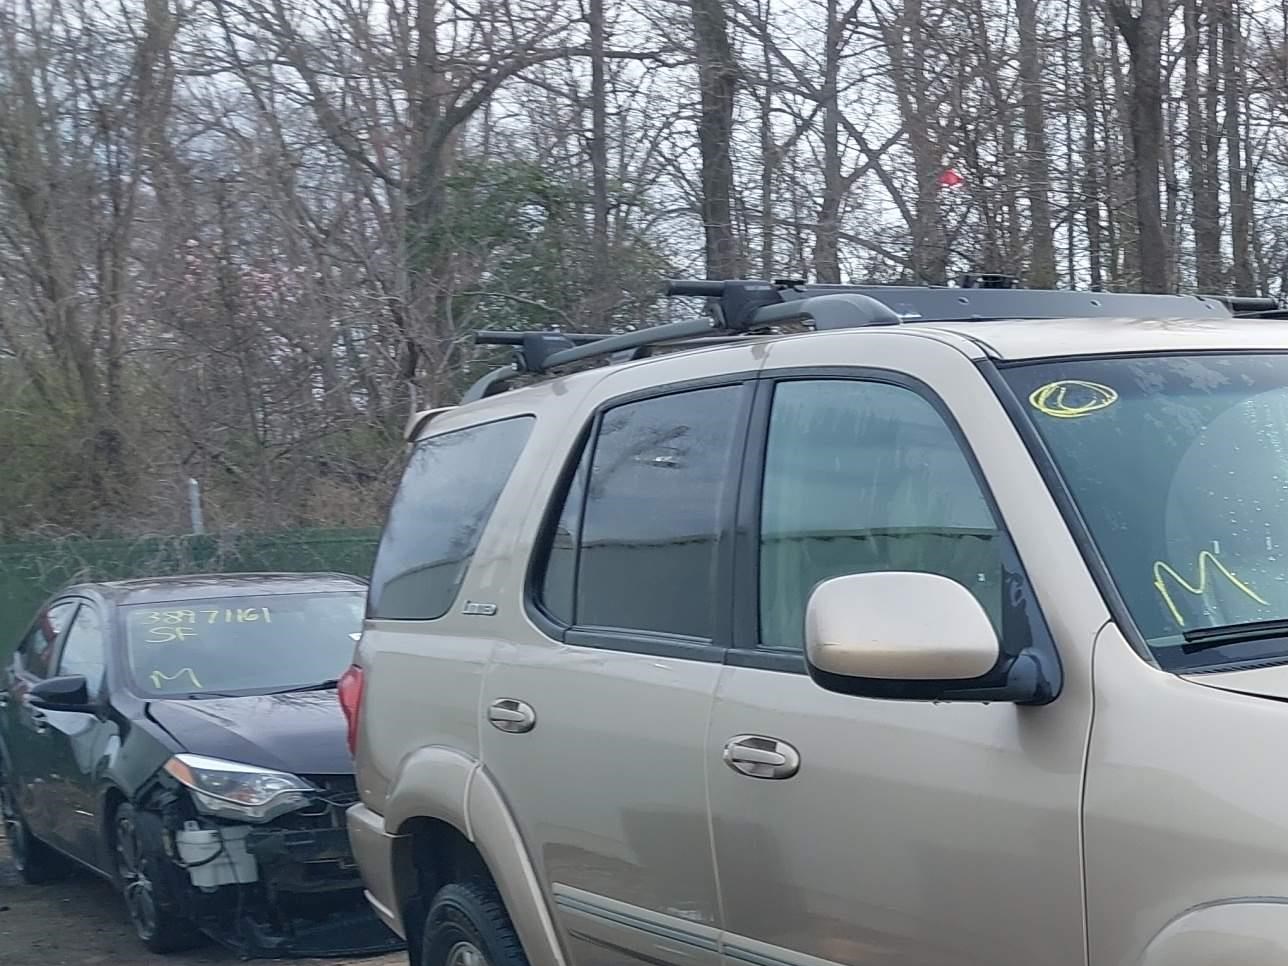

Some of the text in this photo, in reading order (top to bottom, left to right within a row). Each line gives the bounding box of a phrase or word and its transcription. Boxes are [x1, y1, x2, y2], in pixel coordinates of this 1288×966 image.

[1153, 550, 1271, 627] M
[145, 627, 198, 643] SF
[150, 667, 203, 689] M
